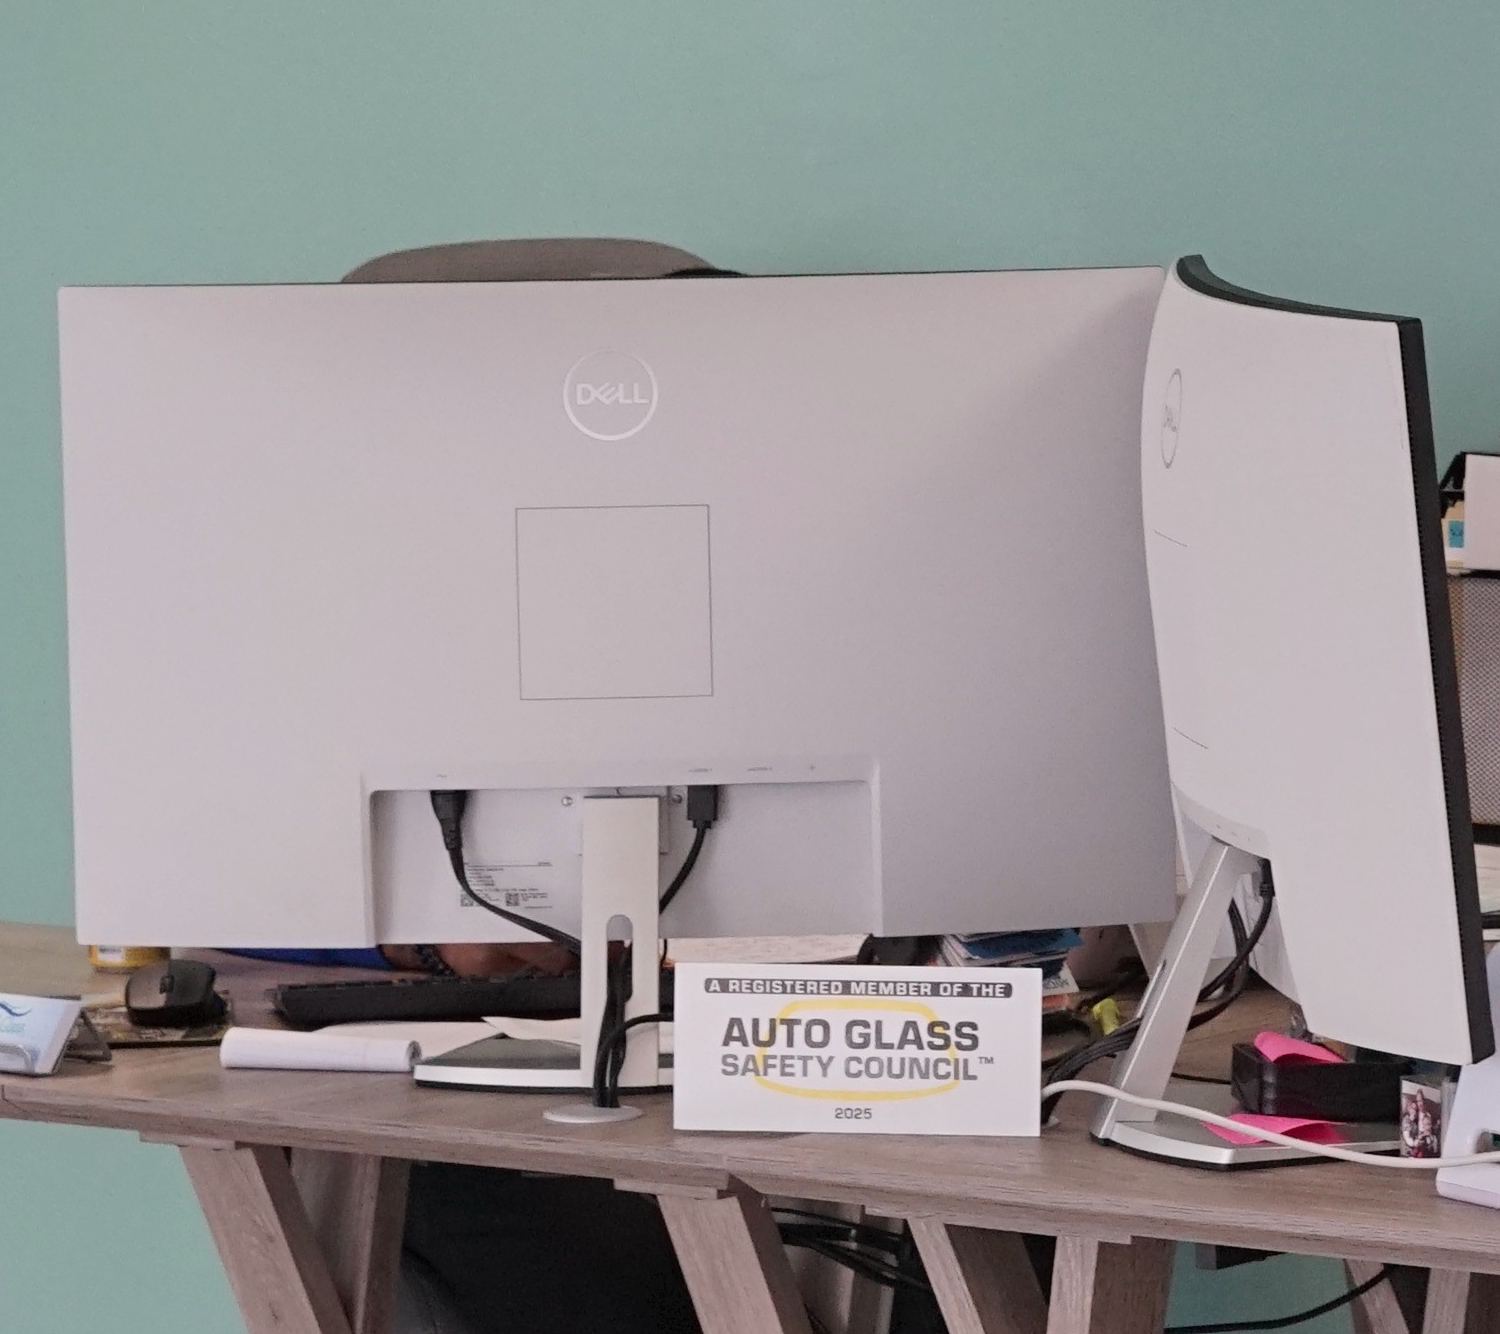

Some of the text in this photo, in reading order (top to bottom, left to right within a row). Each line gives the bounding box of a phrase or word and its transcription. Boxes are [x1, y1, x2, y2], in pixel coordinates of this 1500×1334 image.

[576, 382, 649, 405] DELL
[708, 979, 1006, 997] A REGISTERED MEMBER OF THE
[721, 1017, 979, 1051] AUTO GLASS
[721, 1053, 835, 1078] SAFETY
[834, 1107, 873, 1120] 2025
